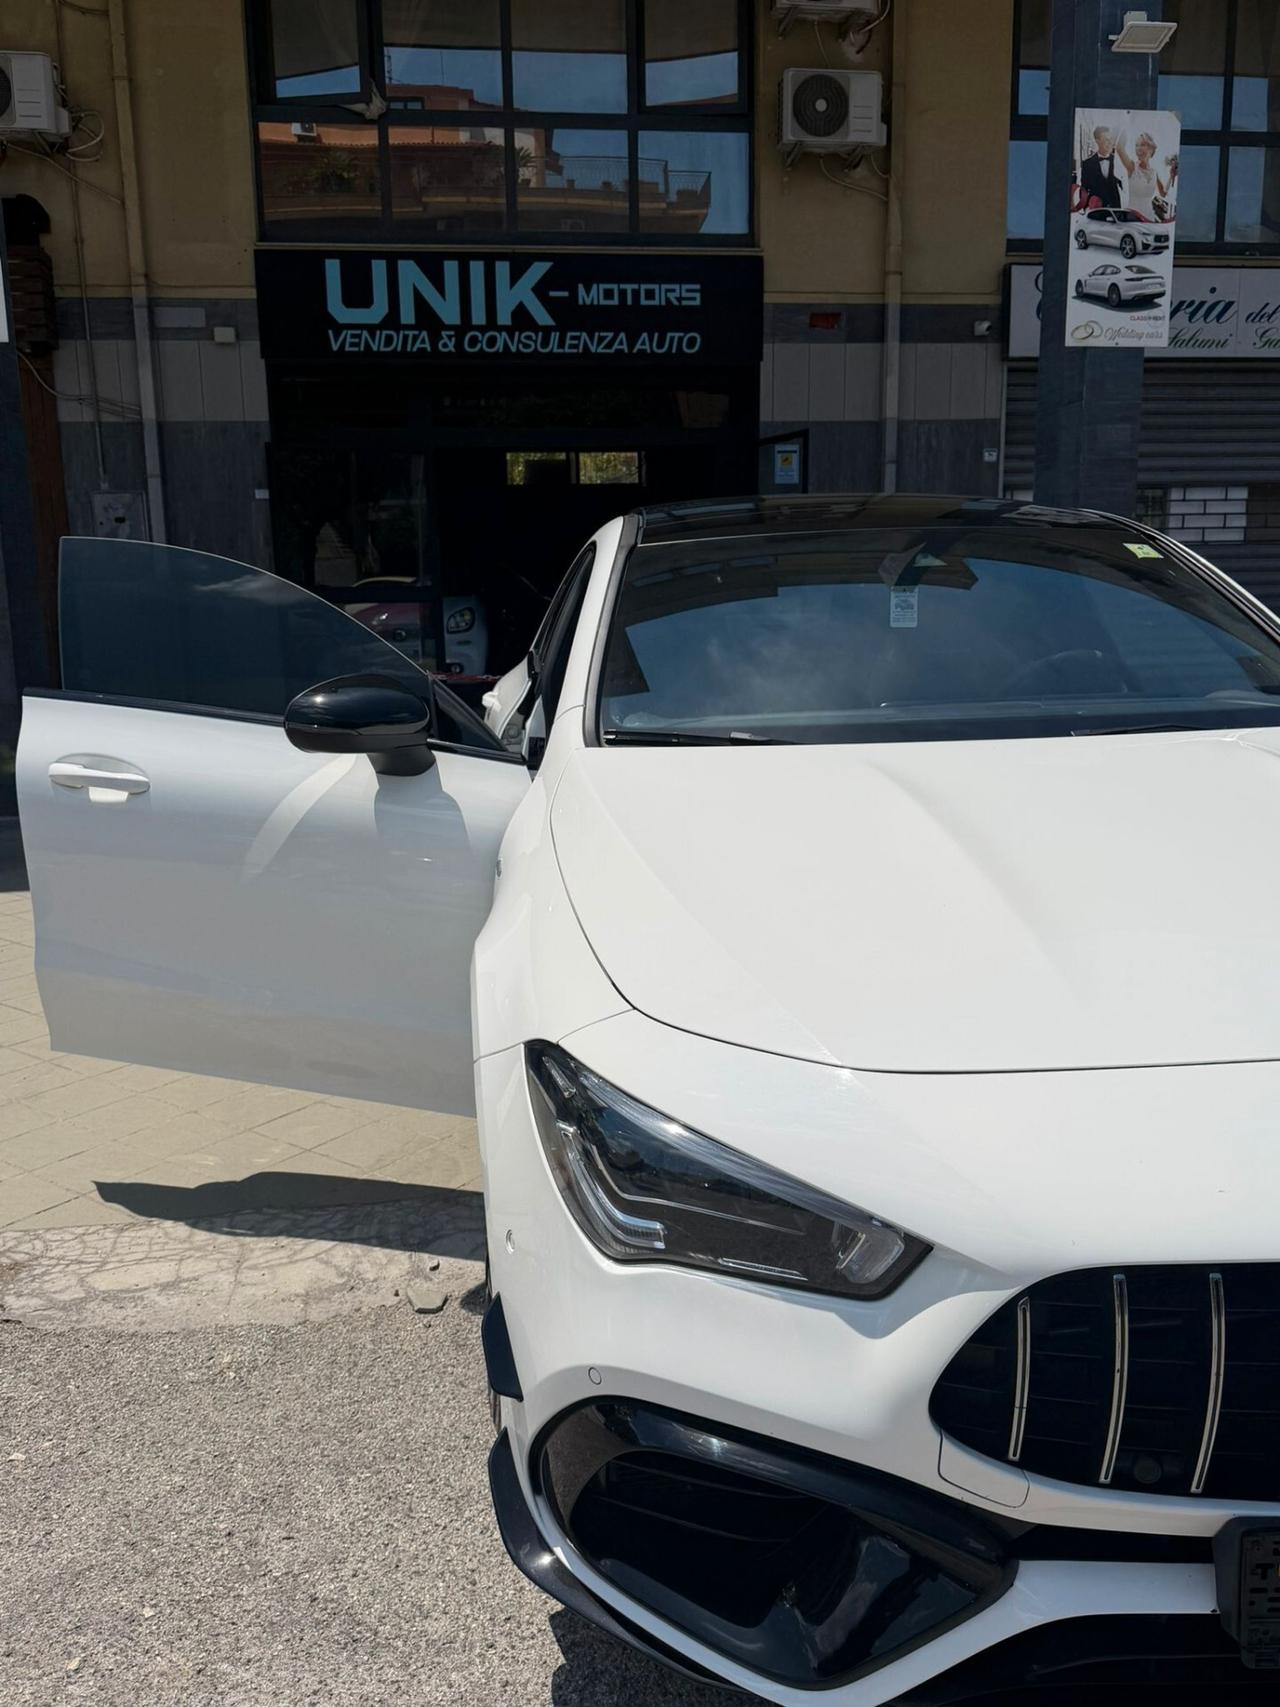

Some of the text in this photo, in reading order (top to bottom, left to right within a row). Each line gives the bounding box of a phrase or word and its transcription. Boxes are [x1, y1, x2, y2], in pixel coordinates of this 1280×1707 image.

[578, 283, 701, 306] MOTORS
[328, 330, 702, 354] VENDITA & CONSULENZA AUTO
